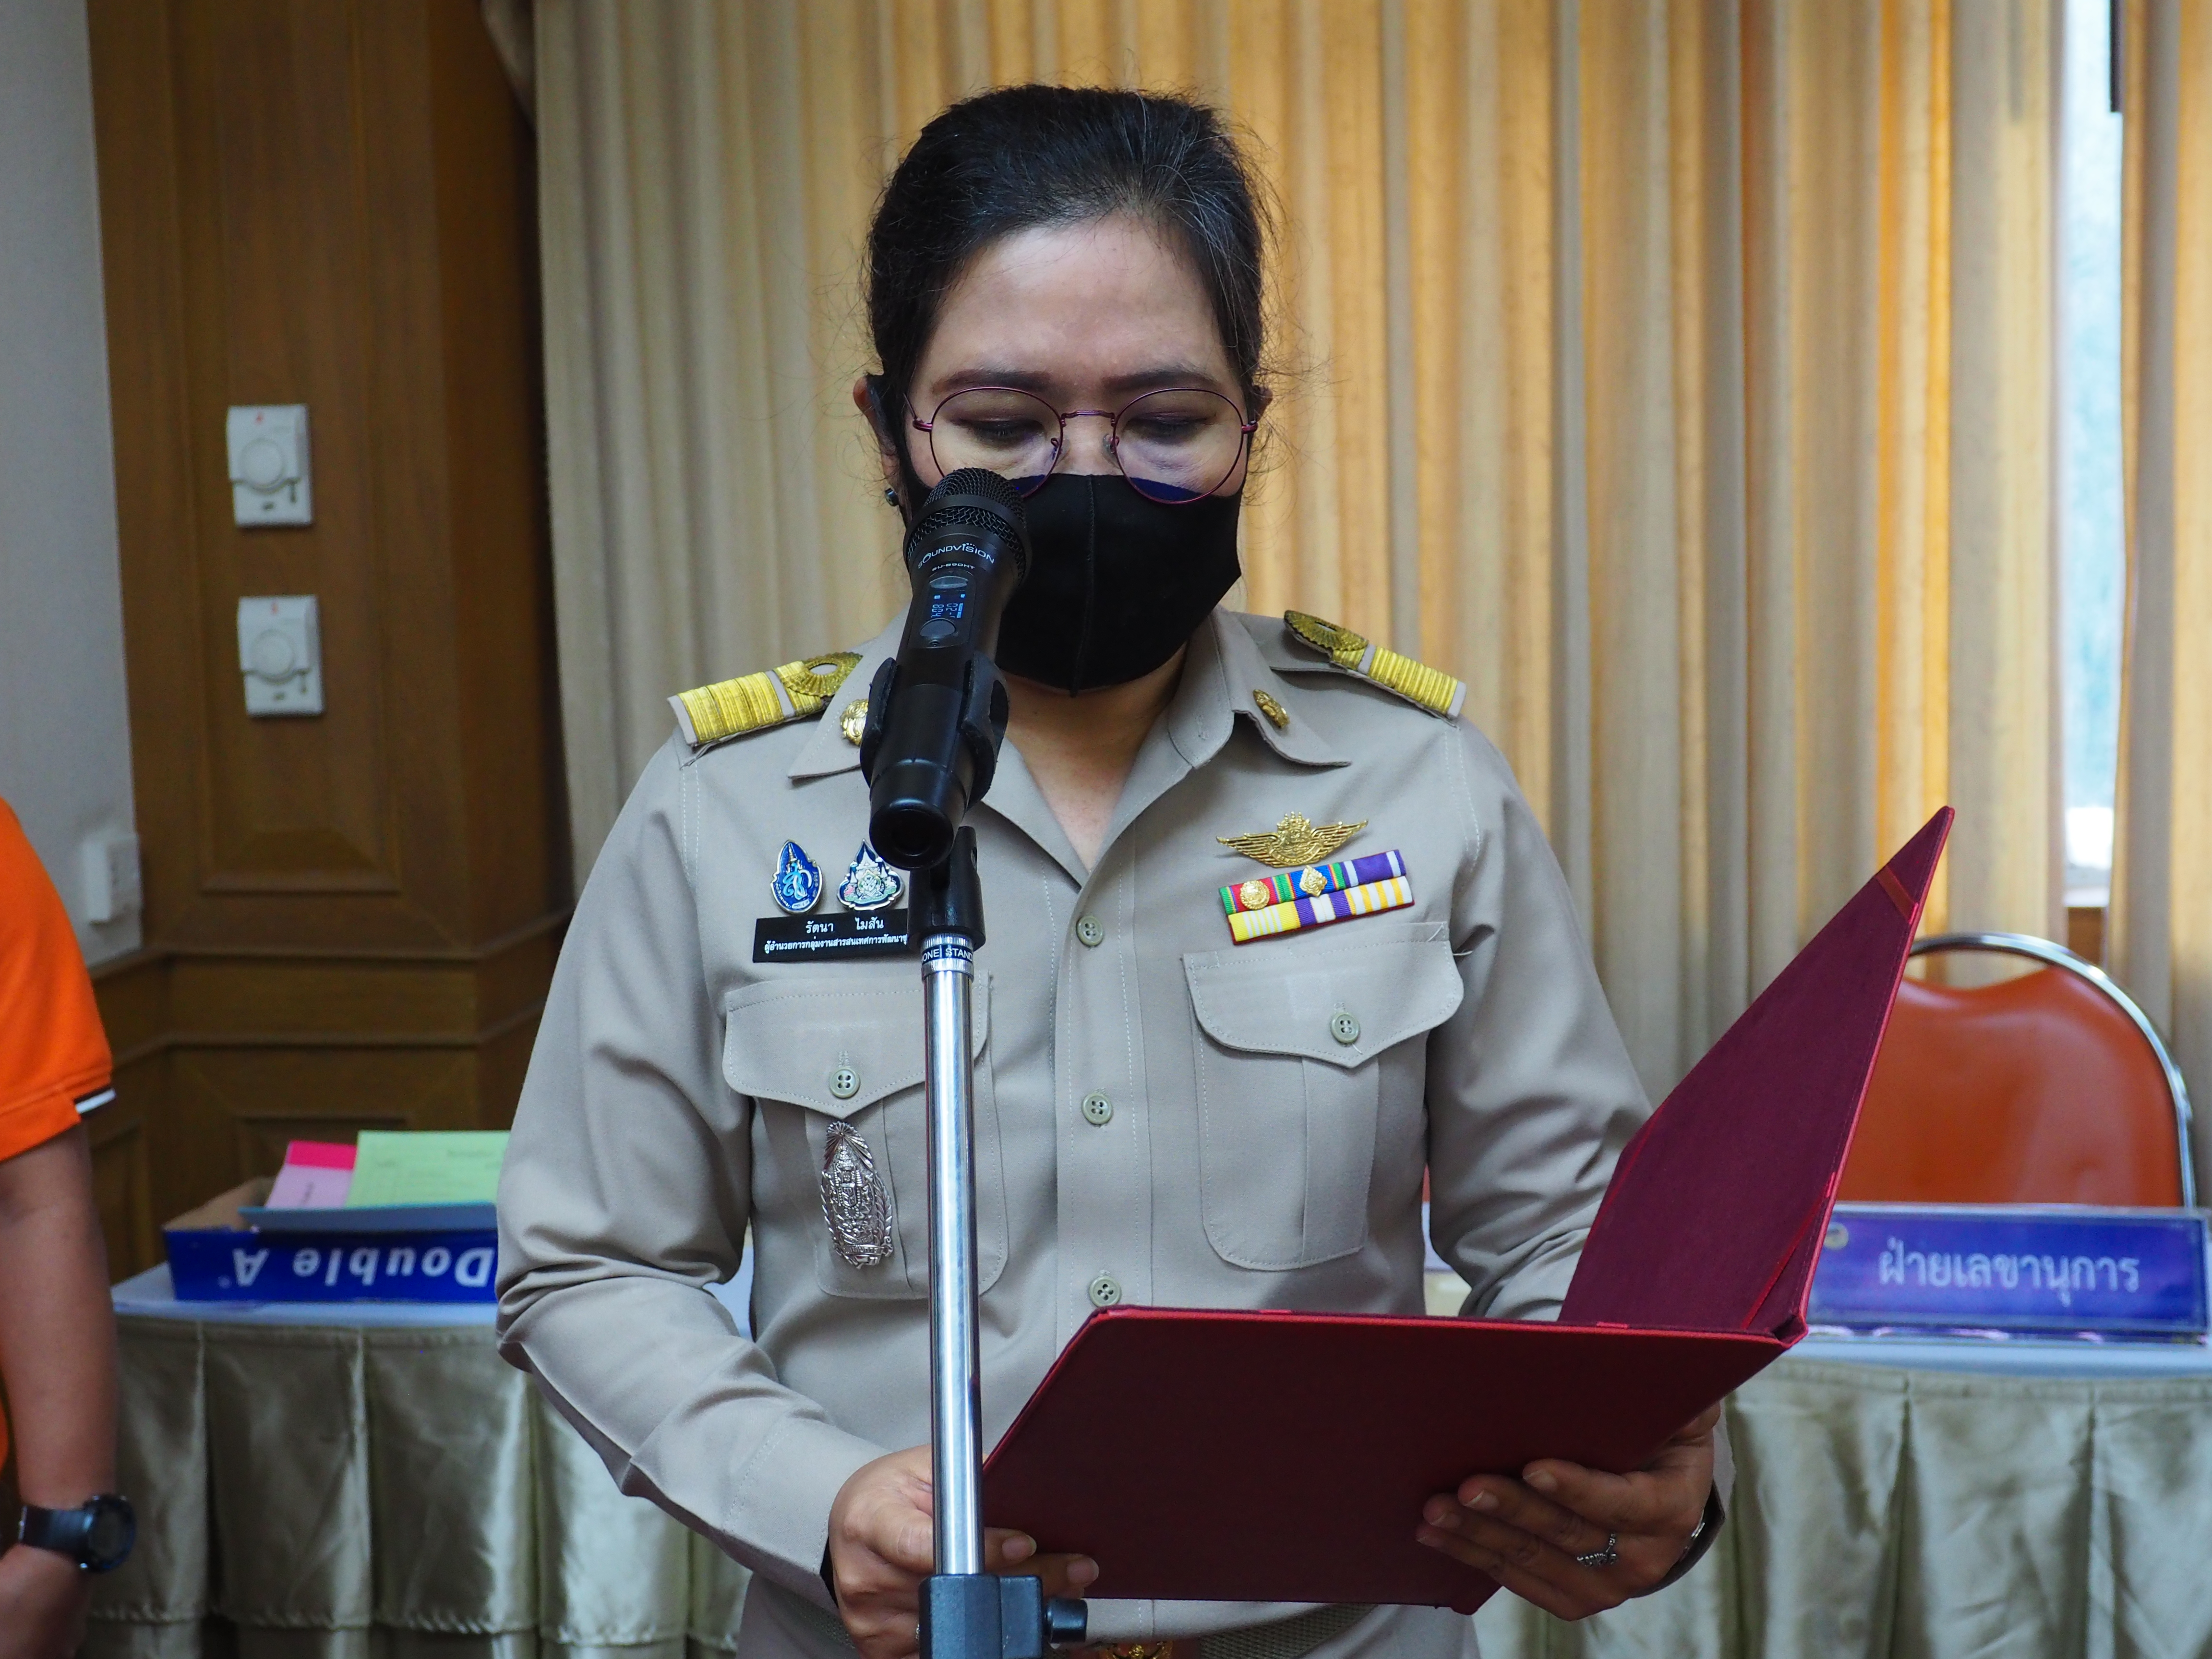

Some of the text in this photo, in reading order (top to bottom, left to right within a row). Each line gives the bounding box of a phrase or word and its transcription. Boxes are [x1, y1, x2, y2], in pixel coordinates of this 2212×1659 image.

[805, 916, 884, 933] รัตนา ไมสัน
[922, 948, 973, 962] ONE STAND
[292, 1248, 494, 1287] Double
[1878, 1235, 2140, 1307] ฝ่ายเลขานุการ
